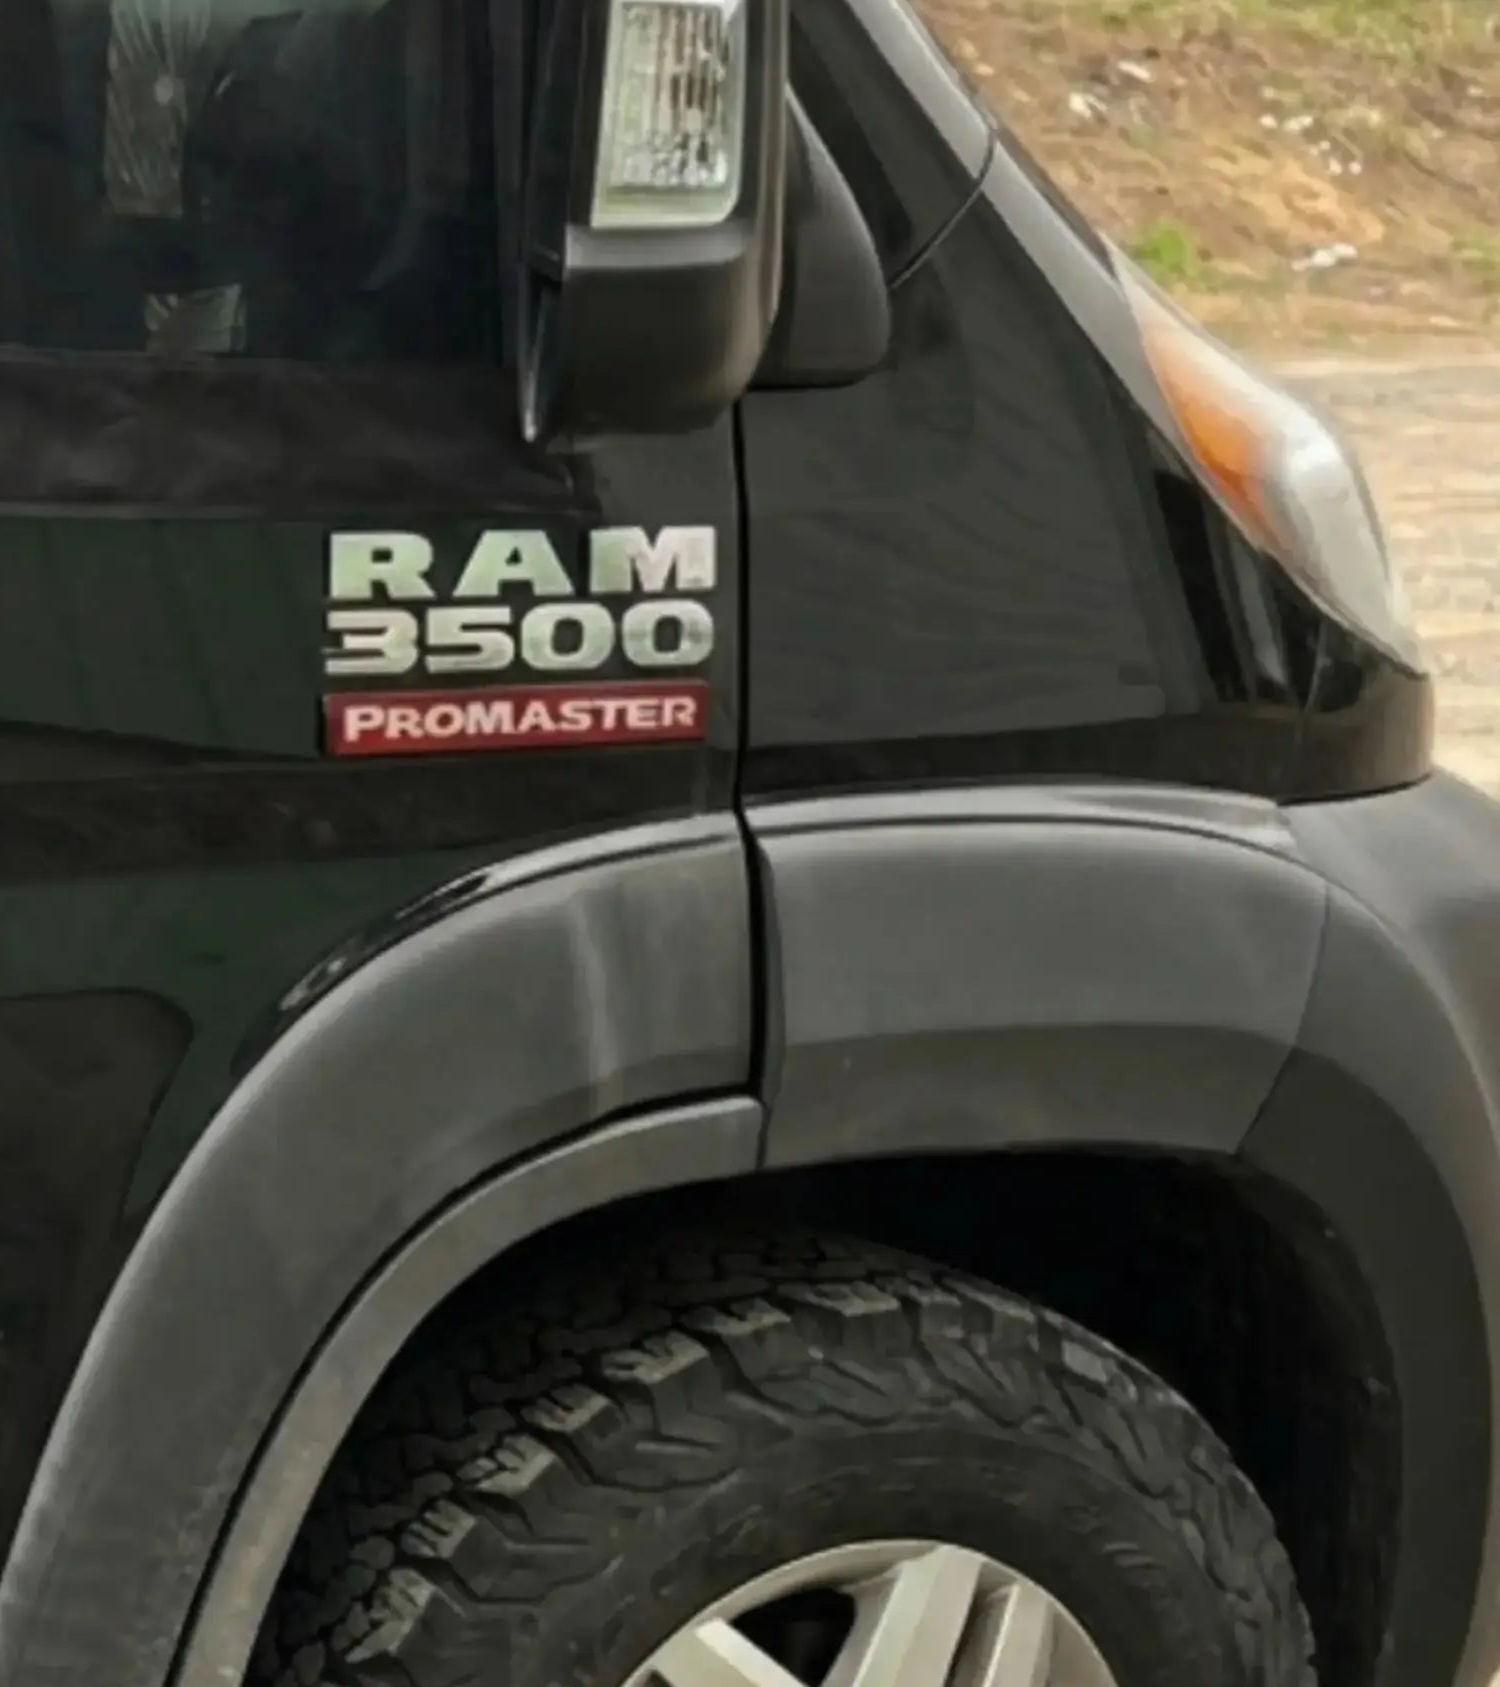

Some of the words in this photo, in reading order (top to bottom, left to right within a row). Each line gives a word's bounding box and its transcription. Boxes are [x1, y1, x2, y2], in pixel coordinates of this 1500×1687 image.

[330, 526, 717, 599] RAM
[324, 599, 715, 675] 3500
[344, 696, 697, 741] PROMASTER
